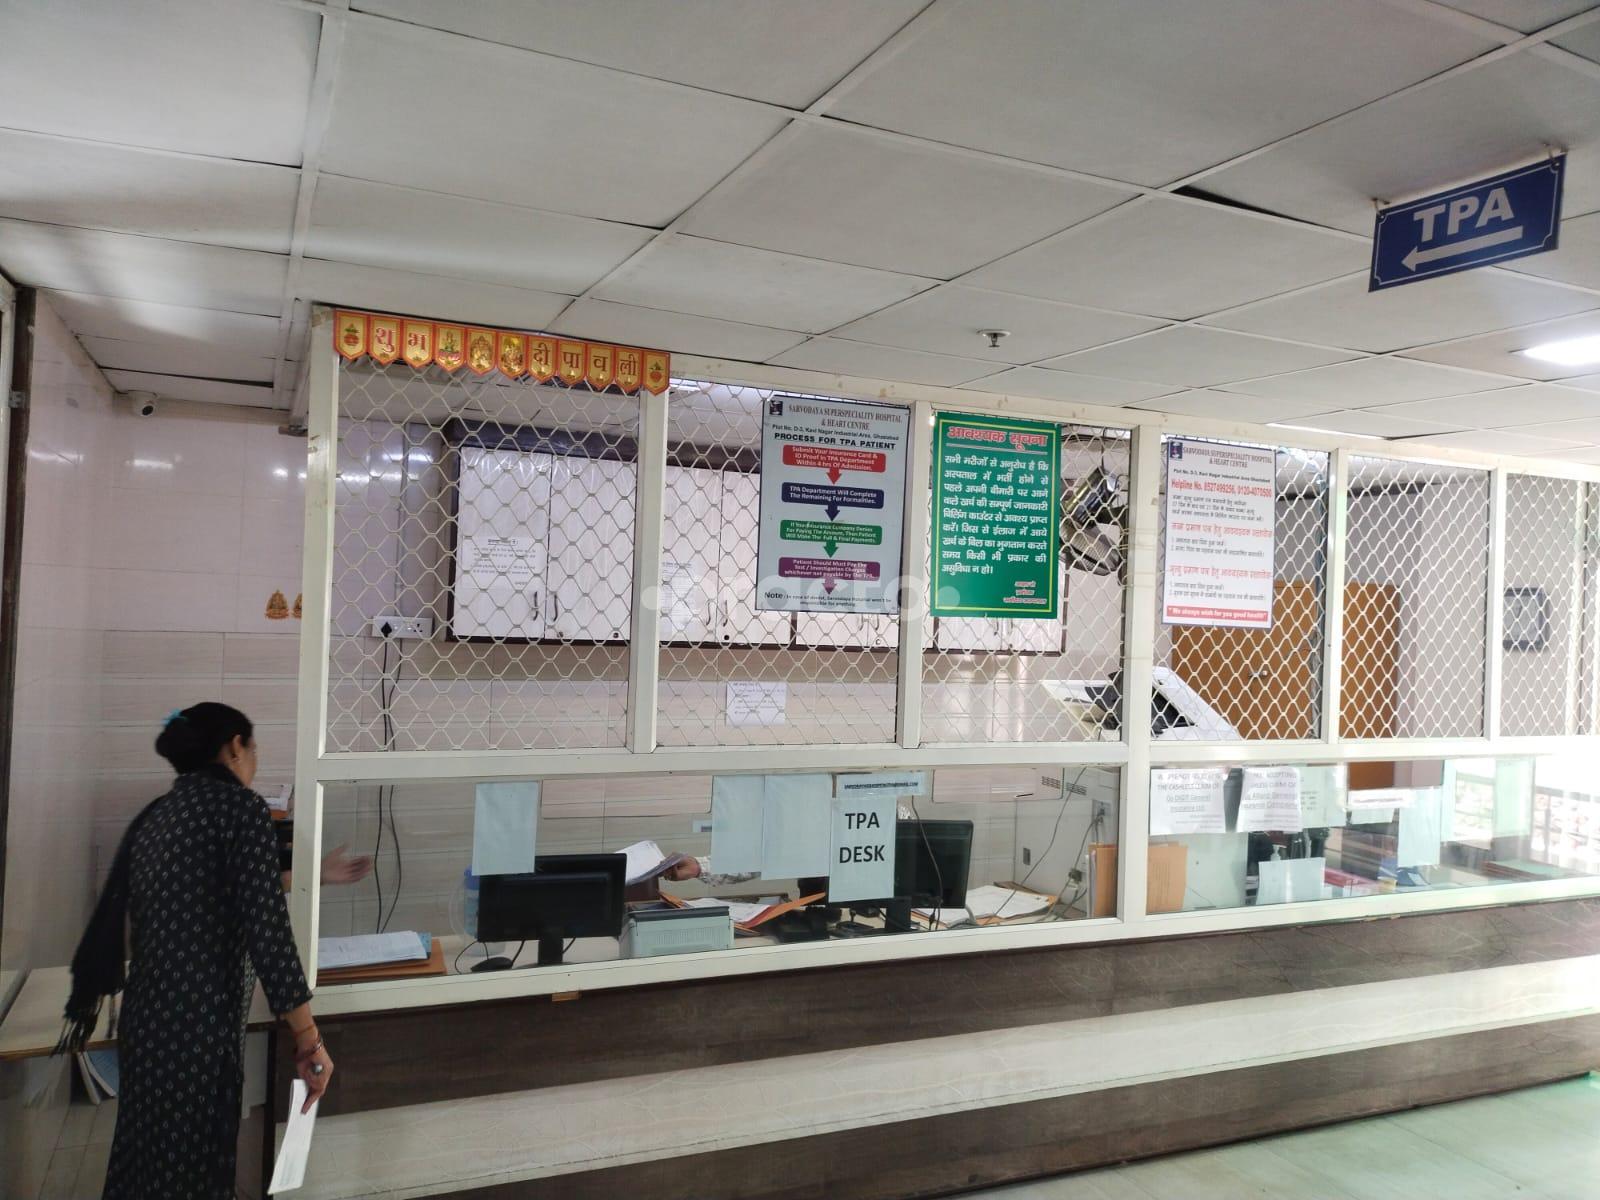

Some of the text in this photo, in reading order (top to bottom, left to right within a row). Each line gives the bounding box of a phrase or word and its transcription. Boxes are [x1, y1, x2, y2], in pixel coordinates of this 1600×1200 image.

[1413, 187, 1515, 242] TPA
[375, 326, 638, 379] शुभ दीपावली
[826, 419, 846, 428] HEART
[847, 421, 869, 430] CENTRE
[774, 432, 896, 449] PROCESS FOR TPA PATIENT
[946, 425, 1048, 453] आवश्यक सूचना
[839, 456, 874, 464] Department
[944, 452, 1048, 472] सभी मरीजों से अनुरोध है कि
[944, 469, 976, 480] अस्पताल
[982, 470, 991, 481] में
[1018, 473, 1033, 484] होने
[1040, 475, 1048, 485] से
[802, 487, 836, 495] Department
[943, 481, 1048, 498] पहले अपनी बीमारी पर आने
[943, 494, 958, 505] वाले
[976, 496, 987, 507] की
[1013, 499, 1047, 511] जानकारी
[943, 507, 966, 519] बिलिंग
[994, 510, 1001, 521] से
[1029, 513, 1047, 524] प्राप्त
[961, 522, 978, 532] जिस
[981, 524, 989, 533] से
[1030, 527, 1047, 536] आये
[957, 536, 966, 546] के
[968, 536, 983, 546] बिल
[984, 537, 995, 547] का
[996, 538, 1025, 551] भुगतान
[1027, 539, 1047, 550] करते
[941, 549, 1046, 563] समय किसी भी प्रकार की
[941, 561, 970, 575] असुविधा
[845, 812, 880, 830] TPA
[840, 845, 885, 864] DESK
